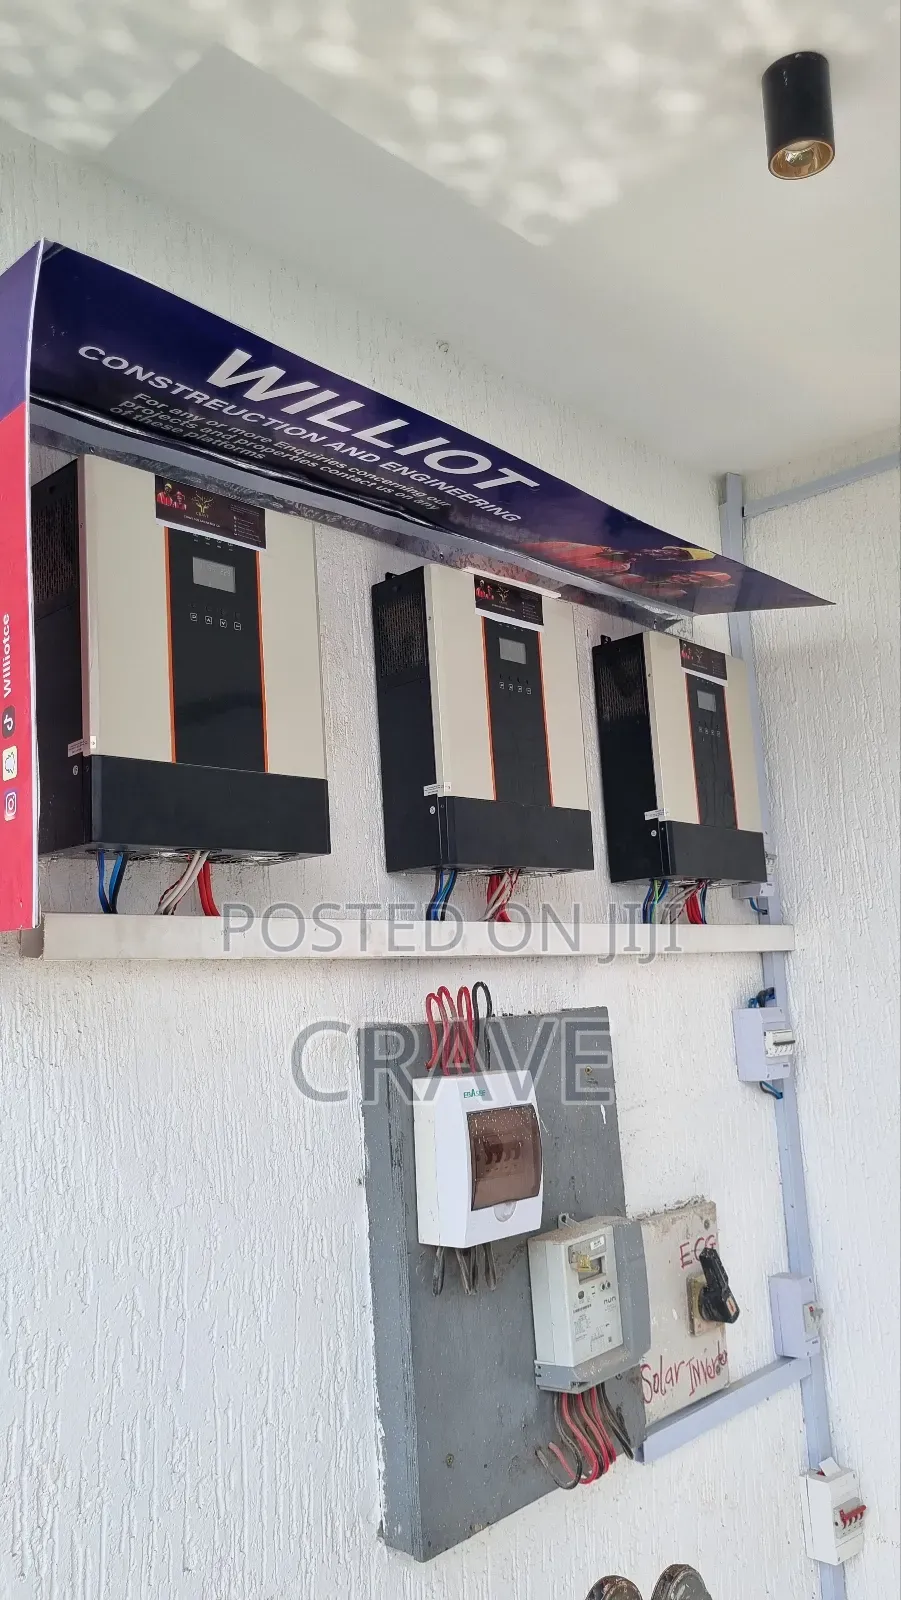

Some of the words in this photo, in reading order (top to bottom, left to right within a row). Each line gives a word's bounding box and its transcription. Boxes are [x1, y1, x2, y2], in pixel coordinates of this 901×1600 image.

[78, 345, 329, 442] CONSTREUCTION
[321, 441, 381, 463] AND
[379, 461, 522, 522] ENGINEERING
[109, 407, 135, 417] of
[133, 414, 184, 434] these
[182, 430, 266, 460] platforms
[118, 400, 198, 430] projects
[199, 427, 238, 440] and
[235, 439, 318, 468] properties
[320, 466, 377, 488] contact
[376, 485, 394, 494] us
[394, 492, 413, 500] on
[413, 499, 440, 511] any
[133, 393, 169, 409] For
[169, 408, 206, 423] any
[206, 420, 228, 428] or
[228, 427, 272, 443] more
[273, 441, 347, 469] Enquiries
[348, 467, 427, 498] concerning
[427, 496, 451, 507] our
[206, 348, 540, 490] WILLIOT
[640, 1354, 685, 1404] Solar
